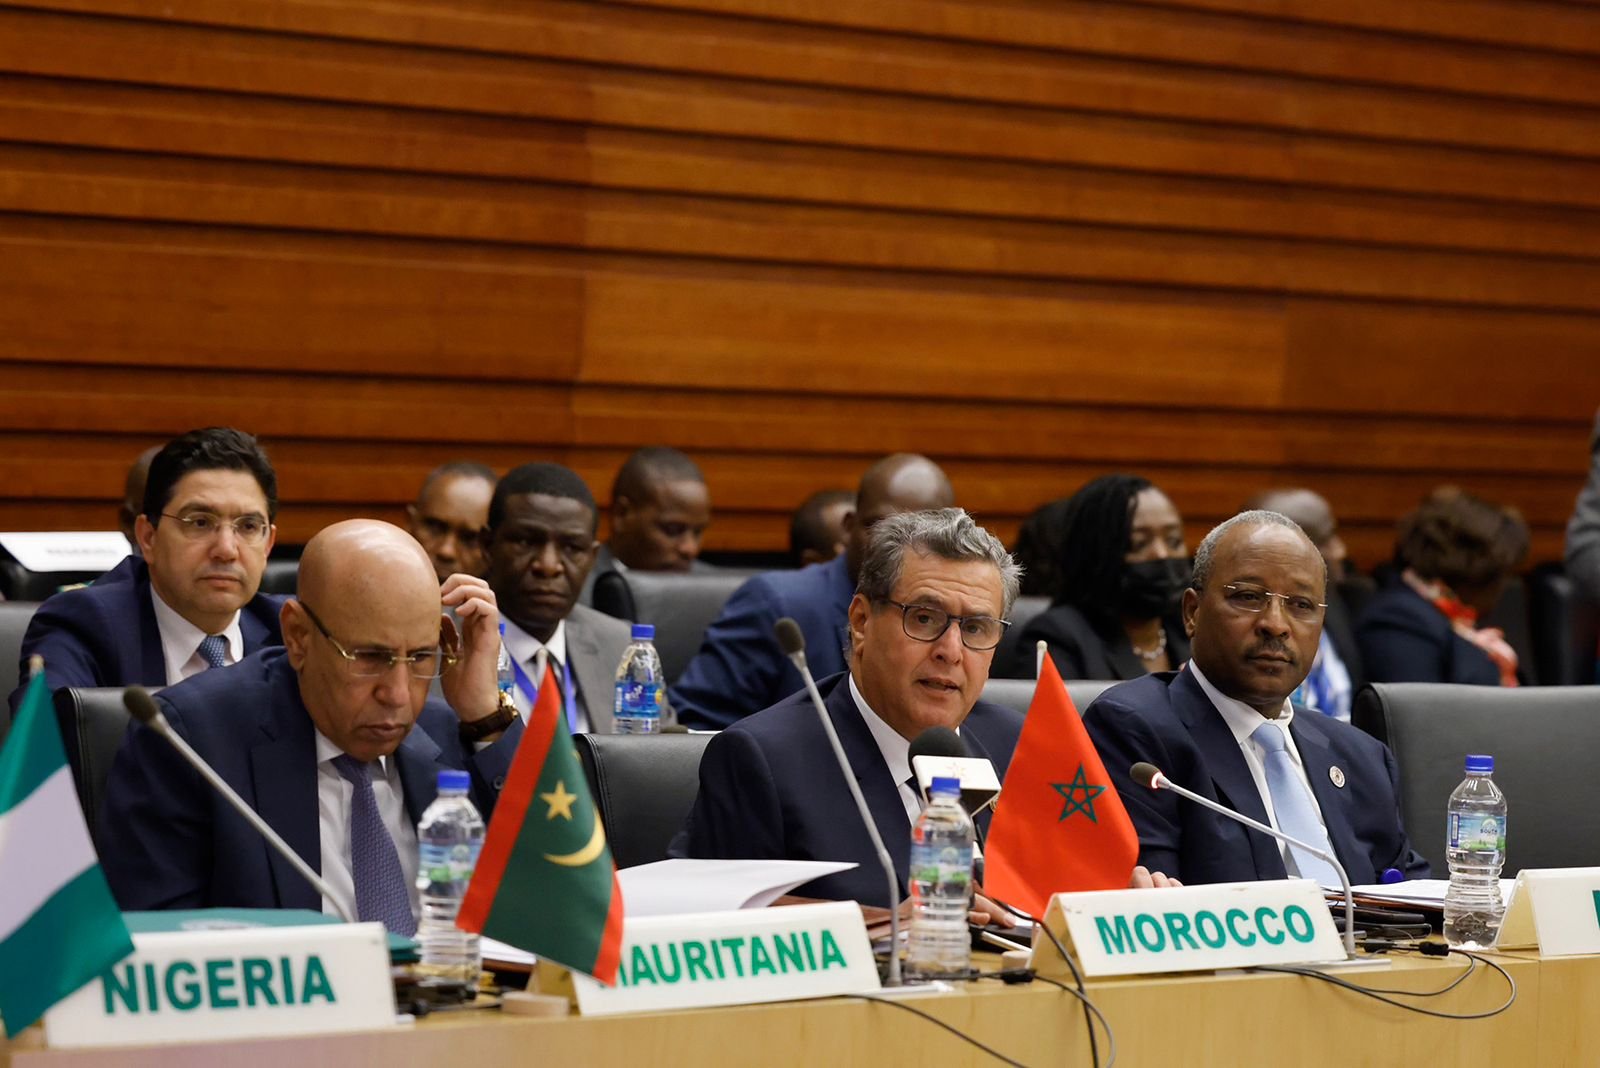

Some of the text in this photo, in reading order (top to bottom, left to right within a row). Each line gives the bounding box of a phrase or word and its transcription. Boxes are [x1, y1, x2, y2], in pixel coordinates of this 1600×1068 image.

[601, 929, 848, 988] AURITANIA
[1094, 904, 1315, 955] MOROCCO
[103, 955, 336, 1014] NIGERIA
